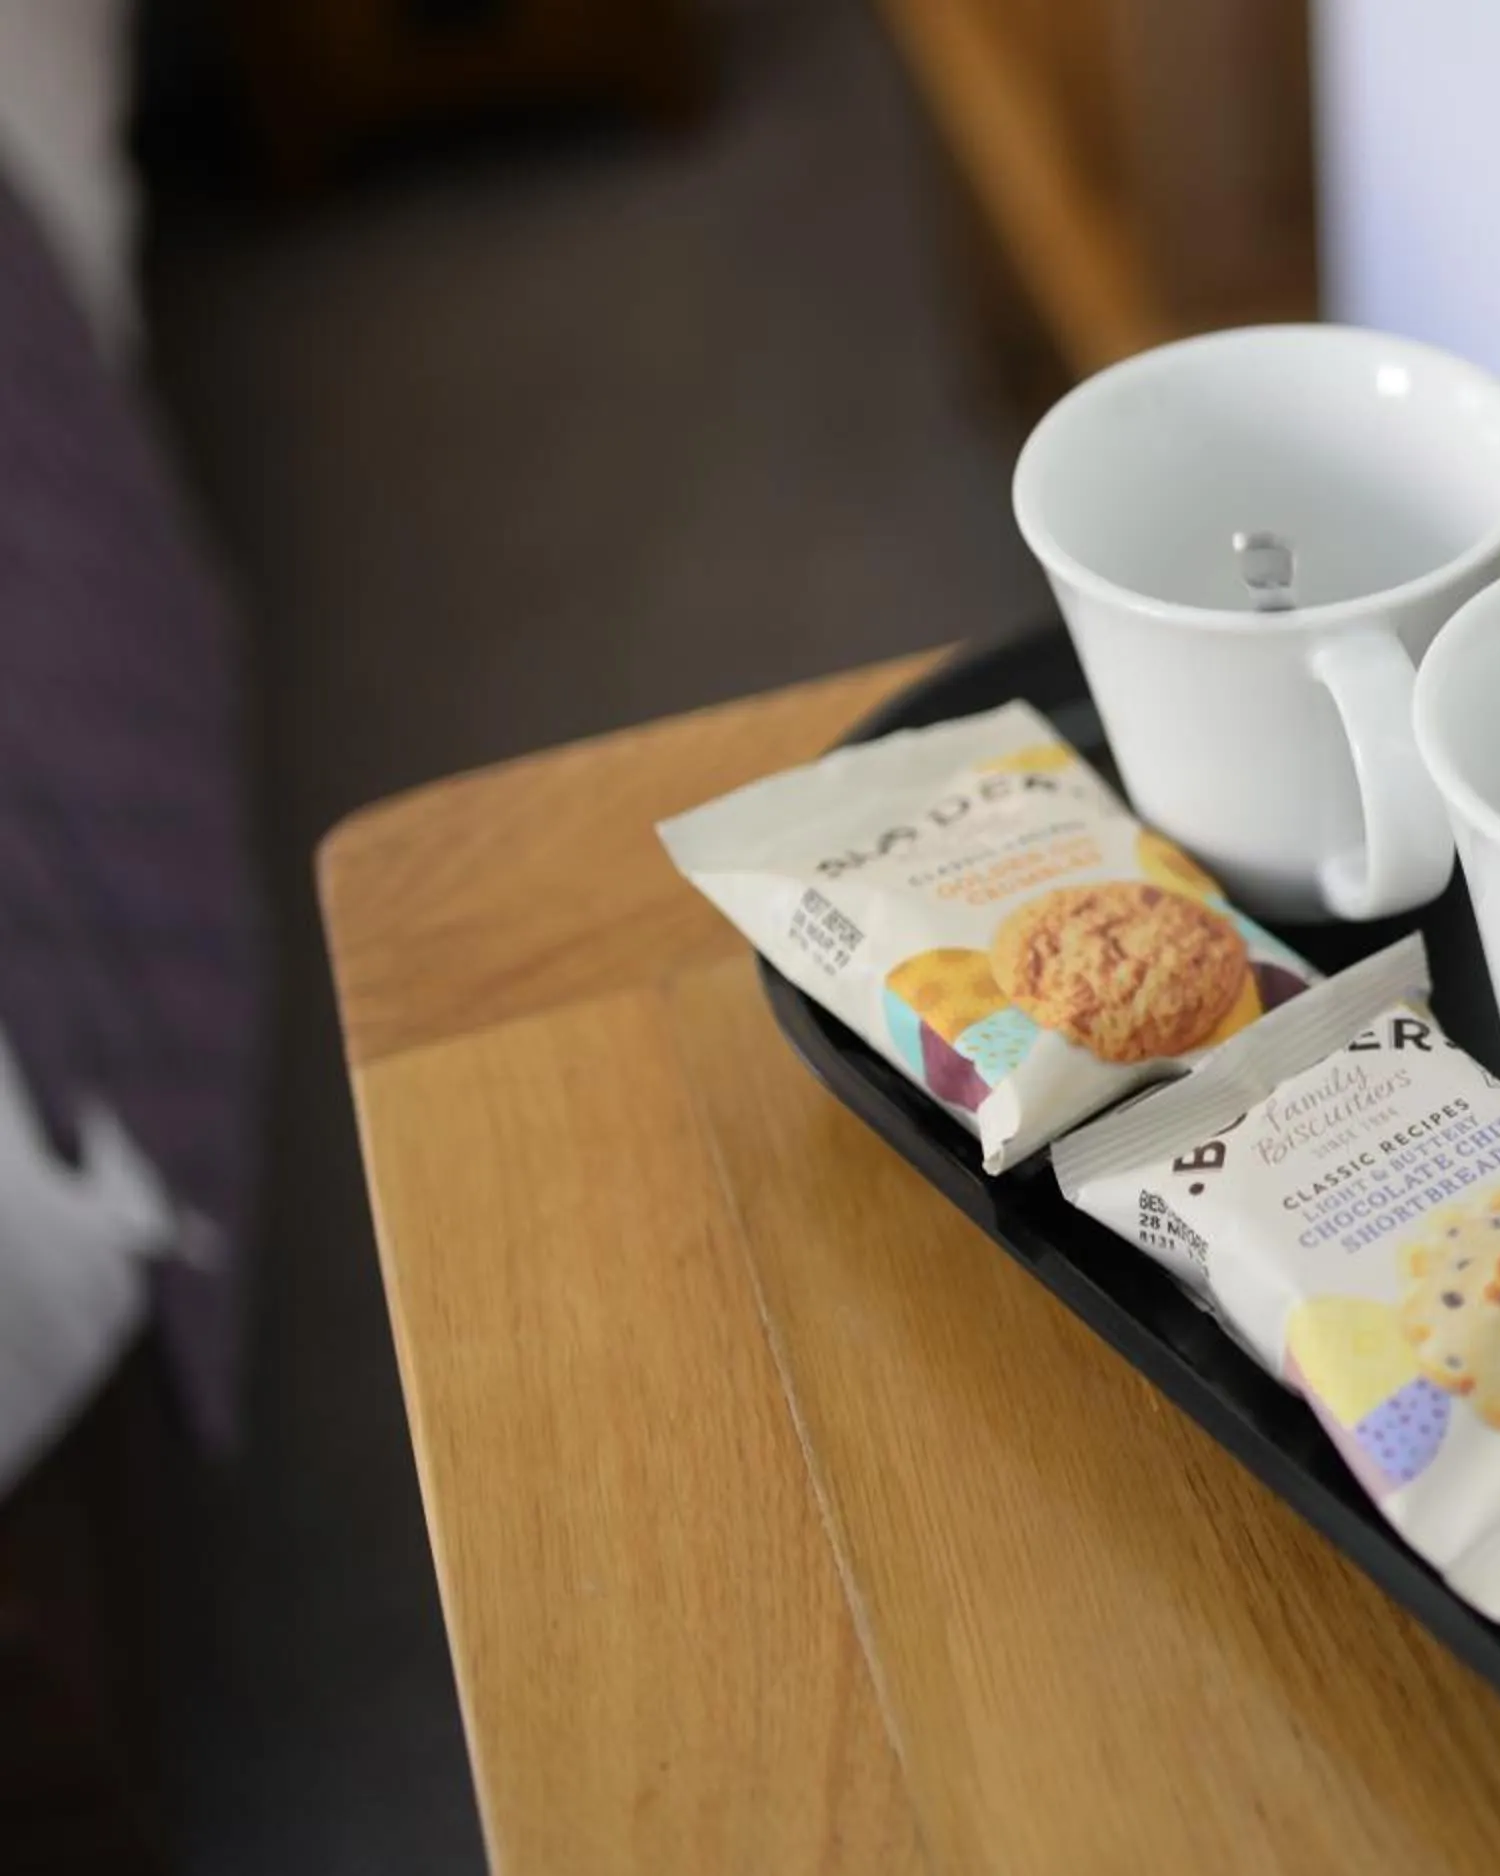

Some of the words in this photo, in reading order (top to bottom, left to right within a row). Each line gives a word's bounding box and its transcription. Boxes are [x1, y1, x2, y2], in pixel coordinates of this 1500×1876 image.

[1282, 1151, 1376, 1211] CLASSIC
[1379, 1097, 1471, 1155] RECIPES
[1297, 1150, 1454, 1249] CHOCOLATE
[1301, 1176, 1369, 1224] LIGHT
[1389, 1113, 1482, 1173] BUTTERY
